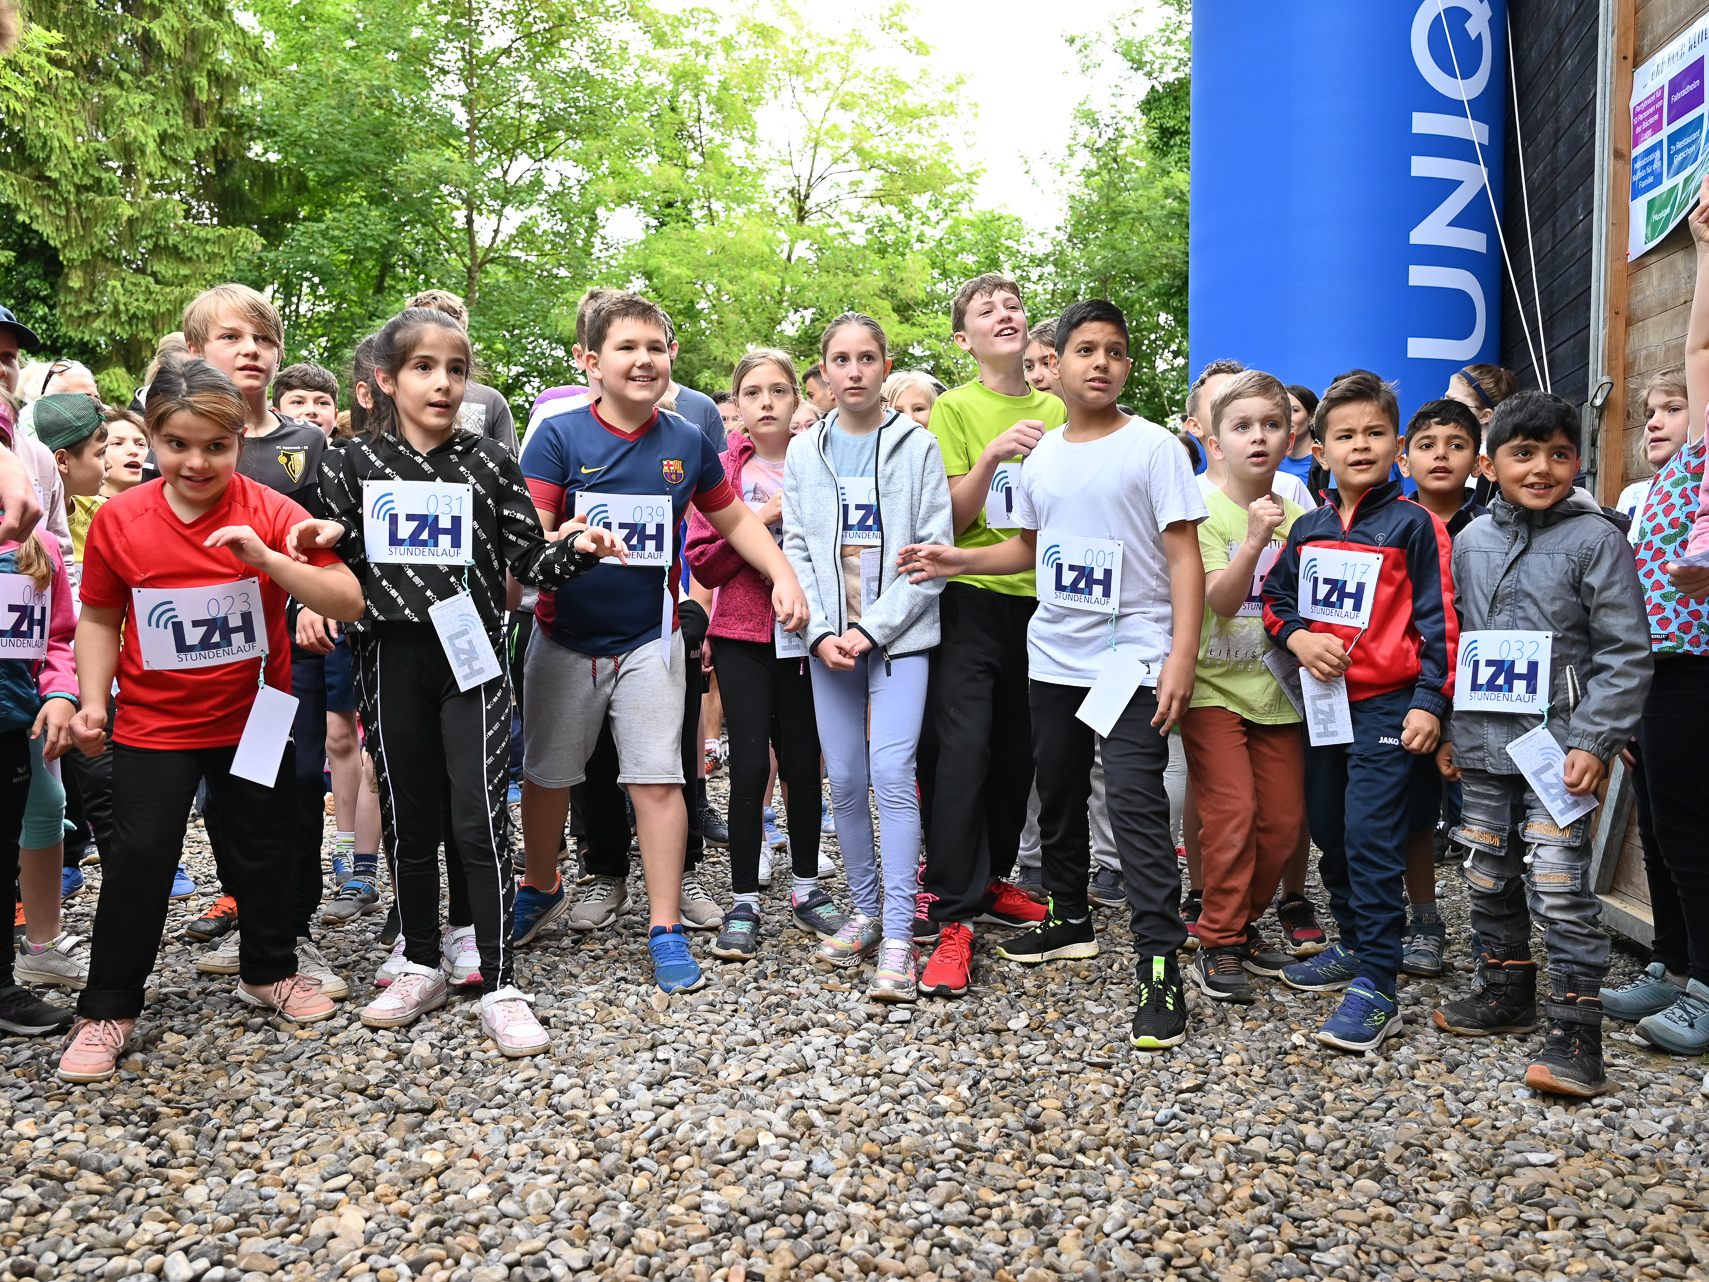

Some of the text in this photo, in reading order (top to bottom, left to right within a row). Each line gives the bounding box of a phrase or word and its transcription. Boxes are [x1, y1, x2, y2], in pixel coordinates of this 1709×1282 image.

[427, 494, 463, 515] 031
[633, 505, 665, 523] 039
[388, 513, 462, 549] LZH
[388, 547, 462, 558] STUNDENLAUF
[1084, 548, 1114, 569] 001
[1054, 562, 1113, 599] LZH
[1340, 562, 1371, 581] 117
[1054, 591, 1111, 606] STUNDENLAUF
[1311, 576, 1366, 612] LZH
[207, 592, 251, 618] 023
[1310, 605, 1360, 620] STUNDENLAUF
[171, 611, 256, 653] LZH
[176, 642, 257, 663] STUNDENLAUF
[1499, 639, 1540, 660] 032
[1470, 659, 1539, 694] LZH
[1469, 692, 1537, 704] STUNDENLAUF
[1378, 736, 1400, 746] JAKO
